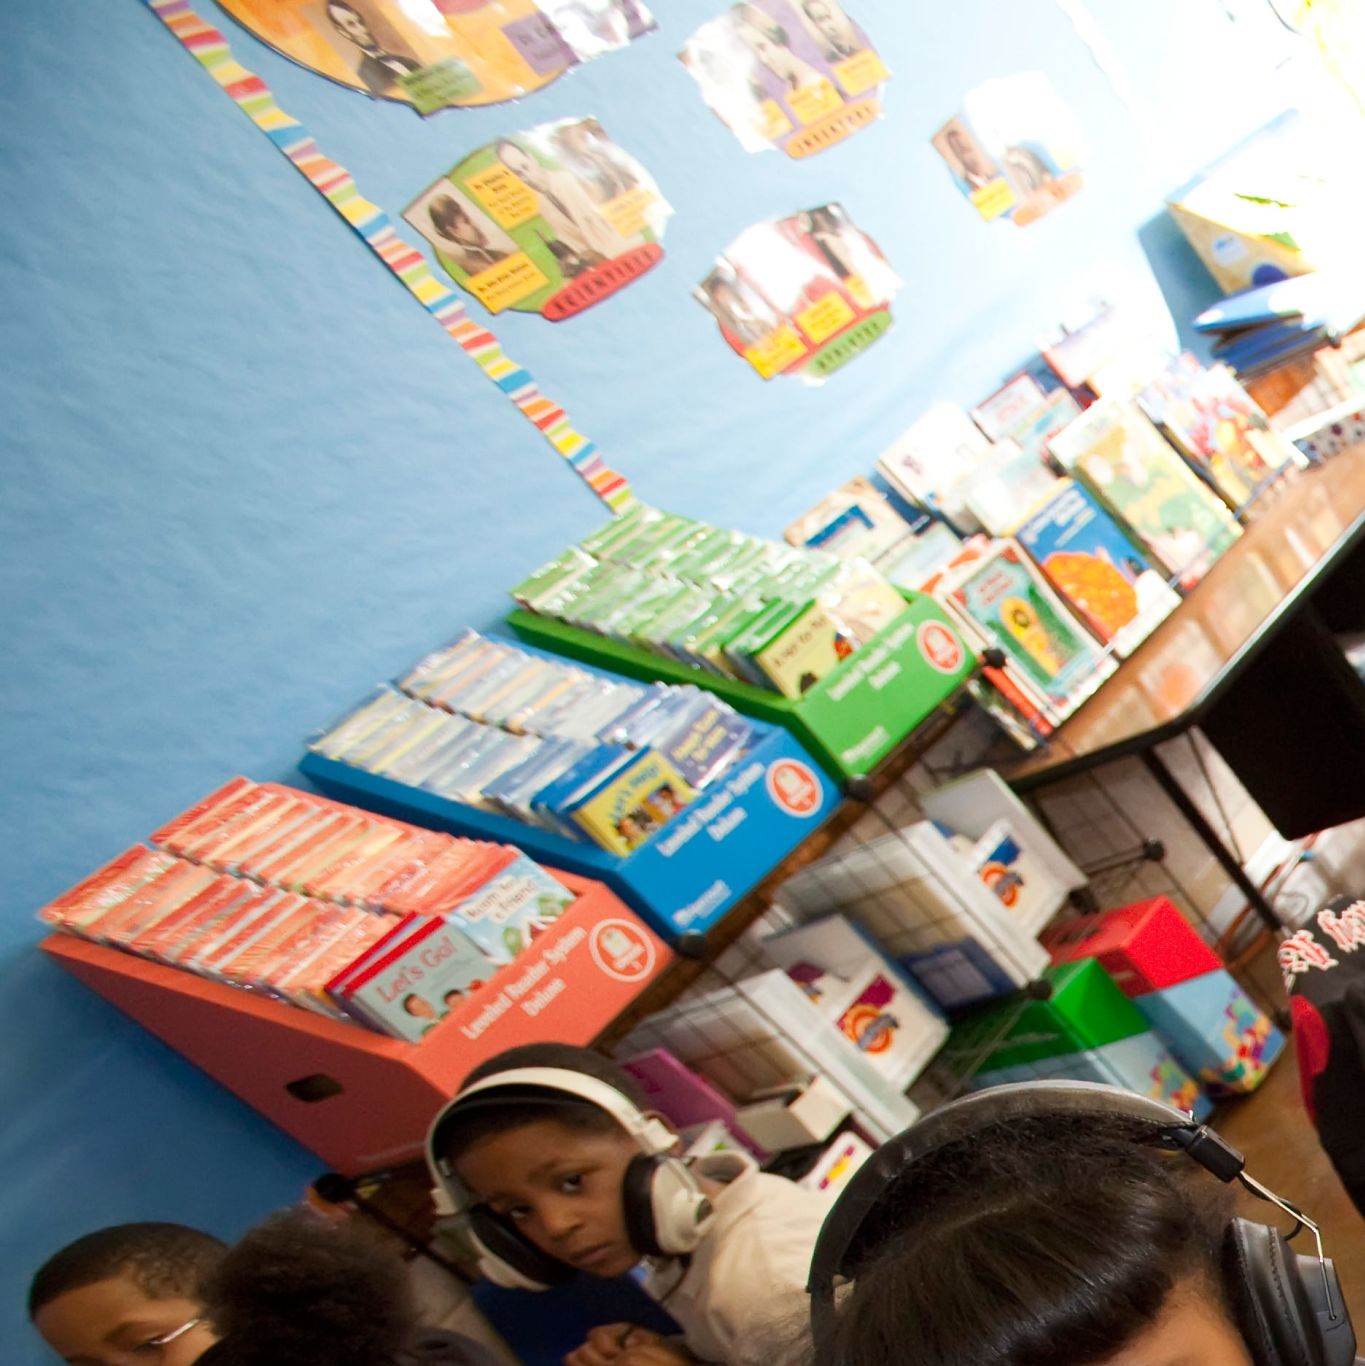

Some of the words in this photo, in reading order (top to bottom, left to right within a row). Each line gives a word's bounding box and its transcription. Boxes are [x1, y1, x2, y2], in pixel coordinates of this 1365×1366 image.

[553, 248, 655, 314] SCIENTISTS
[375, 965, 425, 1004] Let's
[418, 934, 459, 970] Go!
